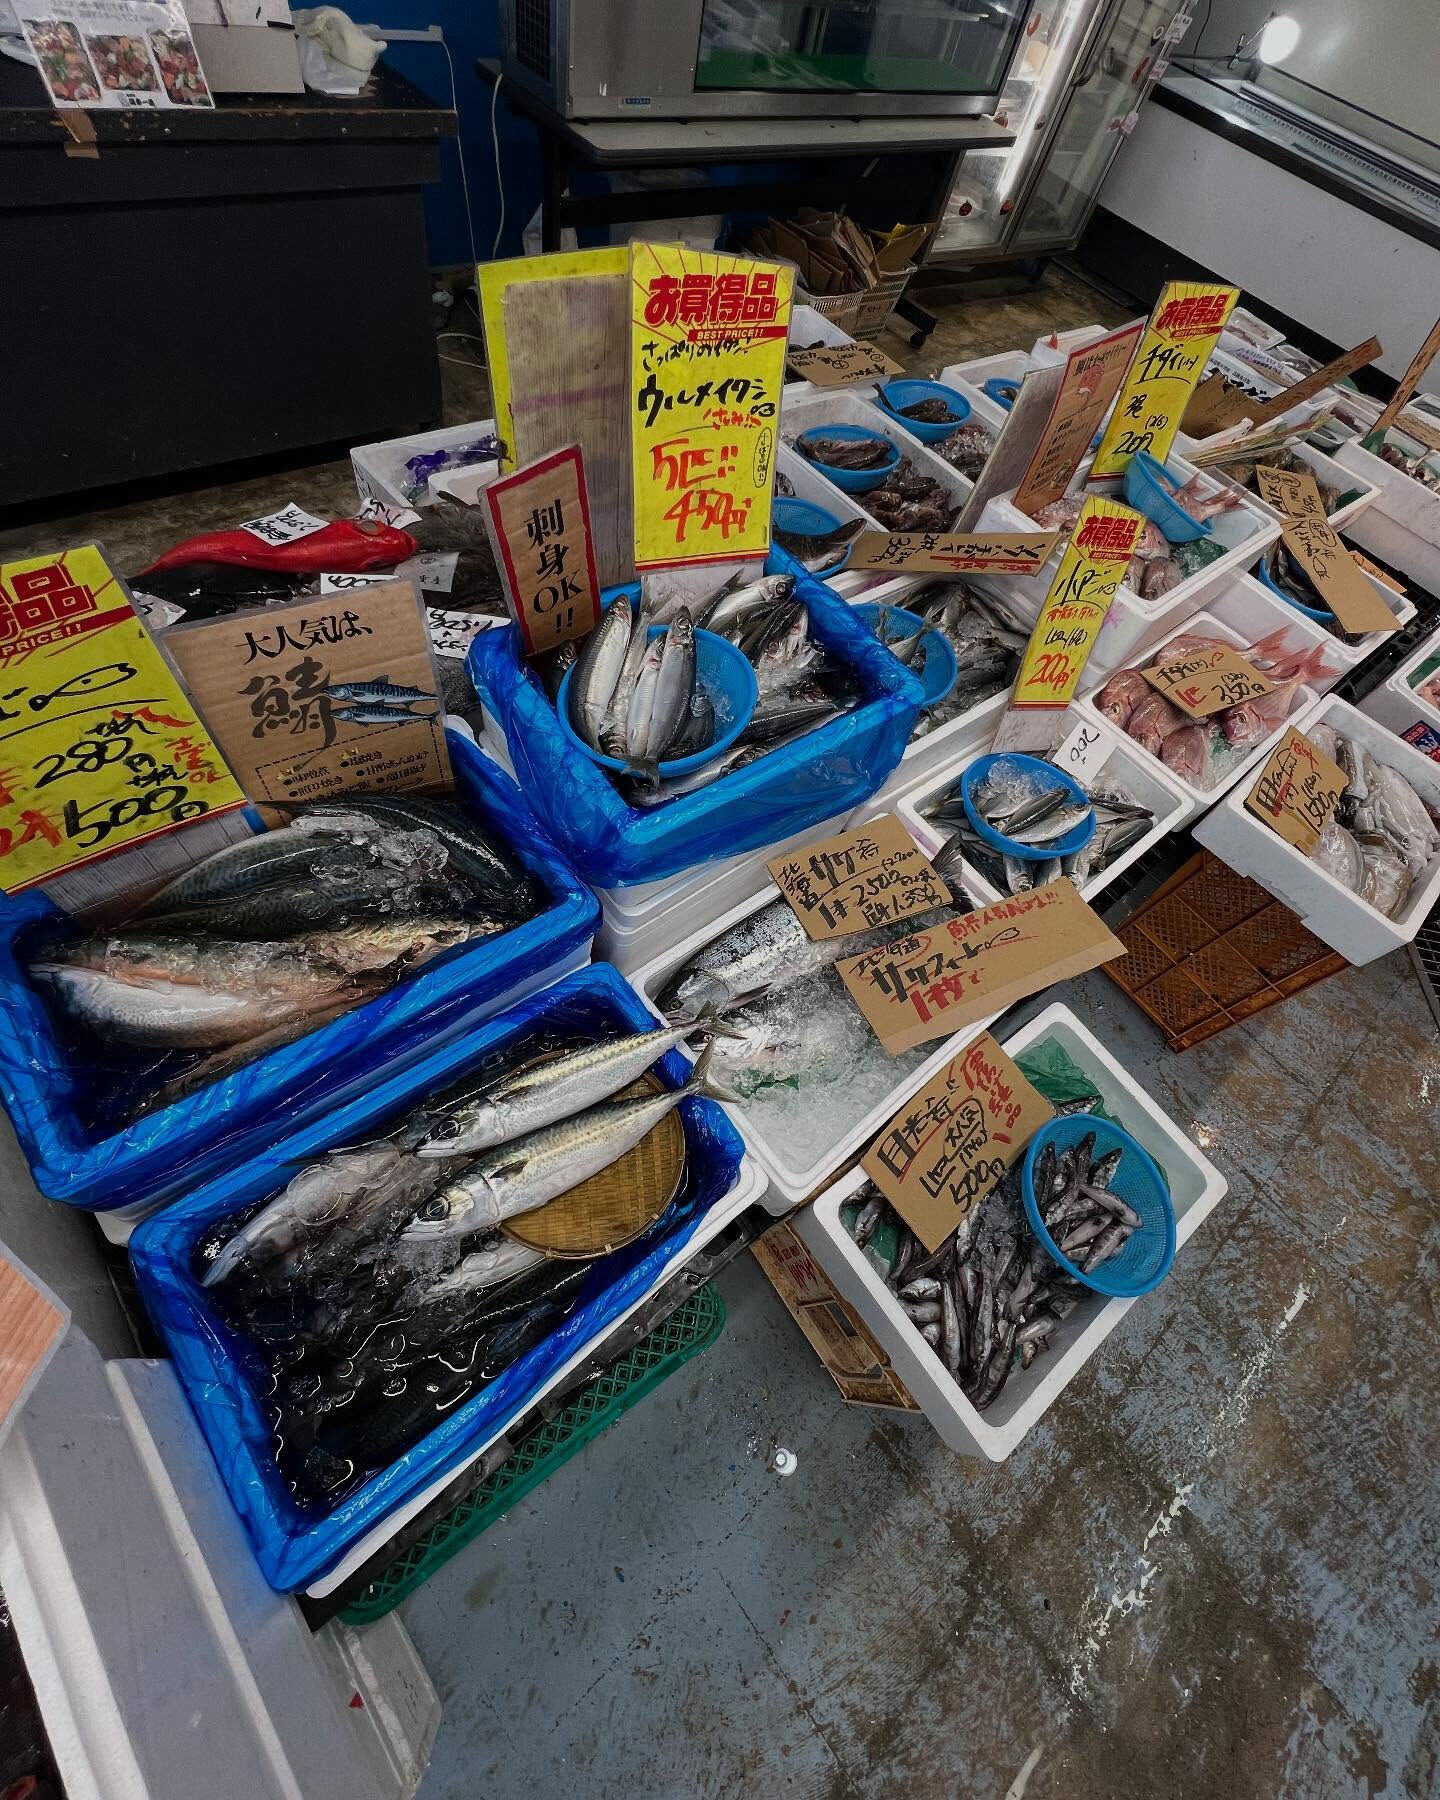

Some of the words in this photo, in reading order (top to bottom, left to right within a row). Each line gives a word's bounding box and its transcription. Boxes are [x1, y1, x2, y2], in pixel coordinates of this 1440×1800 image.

[644, 273, 780, 325] お買得品
[1156, 294, 1230, 330] お買得品
[697, 330, 721, 340] BEST
[727, 328, 763, 338] PRICE!!
[638, 373, 767, 428] ウルメイワシ
[1077, 515, 1139, 550] お買得品
[235, 610, 373, 665] 大人気は、
